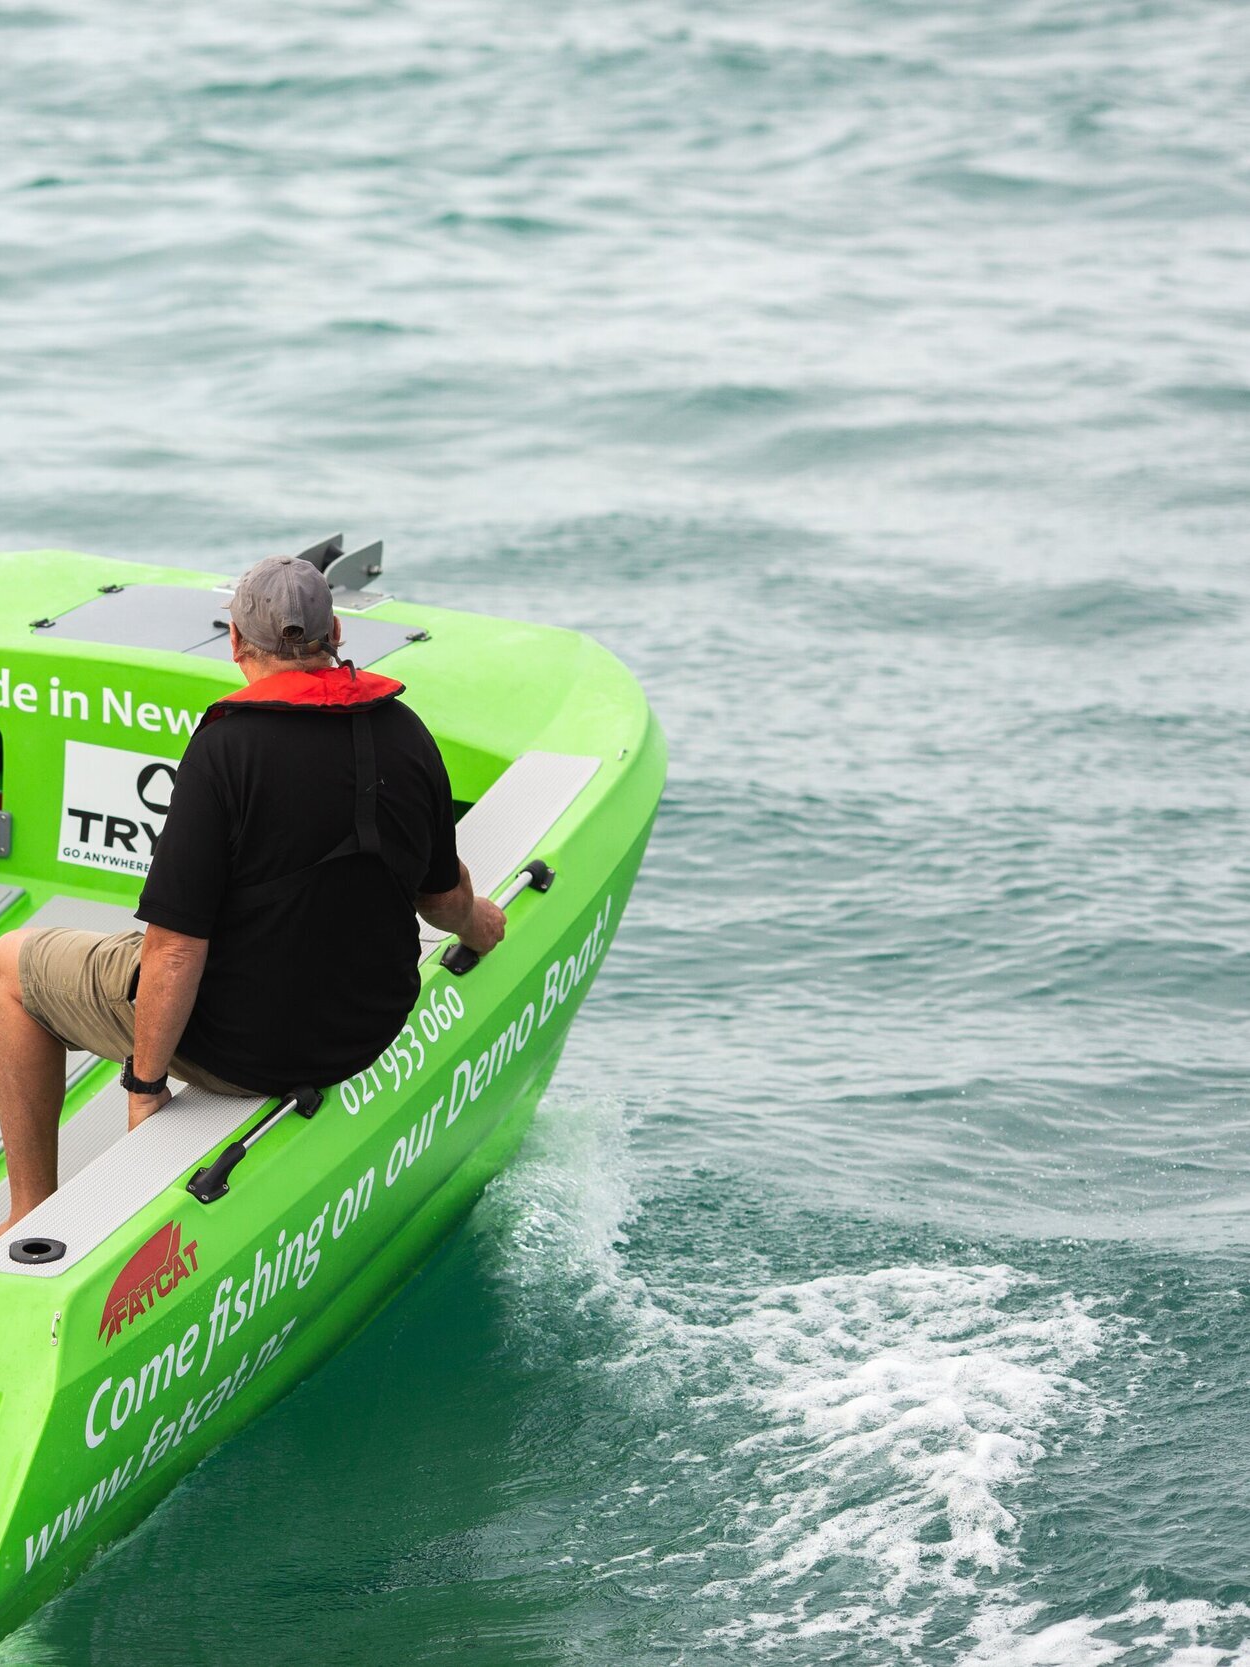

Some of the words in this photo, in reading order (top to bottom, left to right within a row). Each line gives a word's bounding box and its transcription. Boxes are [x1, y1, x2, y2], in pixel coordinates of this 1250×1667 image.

[49, 676, 89, 721] in
[102, 687, 206, 739] New
[62, 847, 80, 858] GO
[84, 851, 150, 873] ANYWHERE
[339, 1065, 383, 1116] 021
[378, 1023, 425, 1093] 953
[418, 985, 465, 1043] 060
[85, 1323, 200, 1449] Come
[199, 1201, 330, 1377] fishing
[332, 1166, 376, 1240] on
[385, 1095, 445, 1188] our
[445, 1002, 535, 1129] Demo
[537, 894, 612, 1029] Boat!
[110, 1239, 199, 1336] FATCAT
[24, 1316, 298, 1574] www.fatcat.nz
